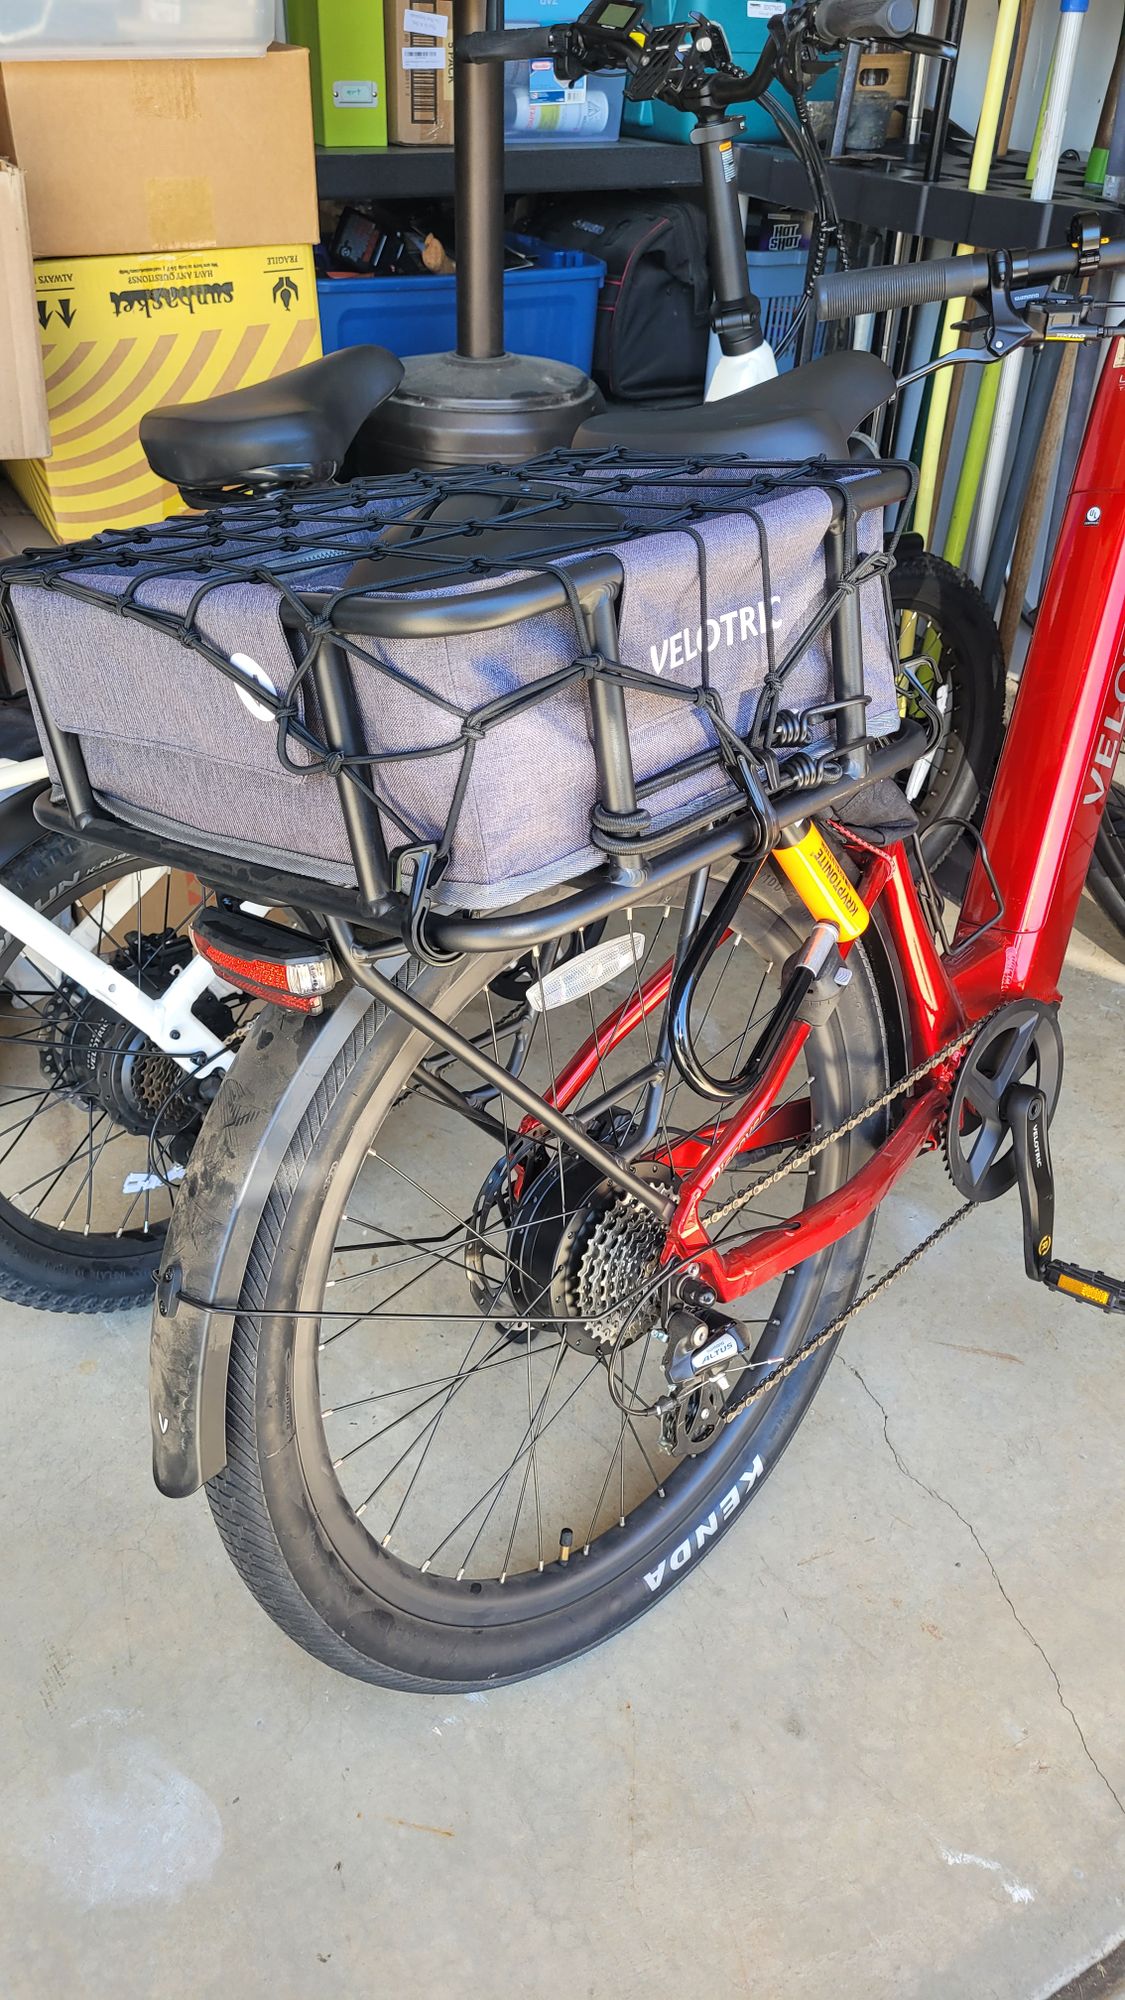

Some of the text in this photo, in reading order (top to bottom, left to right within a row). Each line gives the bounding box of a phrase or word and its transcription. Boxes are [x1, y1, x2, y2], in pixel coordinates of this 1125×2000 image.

[769, 234, 802, 250] SHOT
[773, 224, 799, 237] HOT
[266, 255, 298, 266] FRAGILE
[38, 273, 73, 284] ALWAYS
[128, 270, 213, 284] HAVE ANY QUESTIONS?
[110, 281, 234, 318] sunbasket
[650, 595, 783, 675] VELOTRIC
[814, 848, 859, 917] KRYPTONITE
[1032, 1123, 1043, 1169] VELOTRIC
[701, 1341, 733, 1365] ALTUS
[643, 1454, 764, 1592] KENDA
